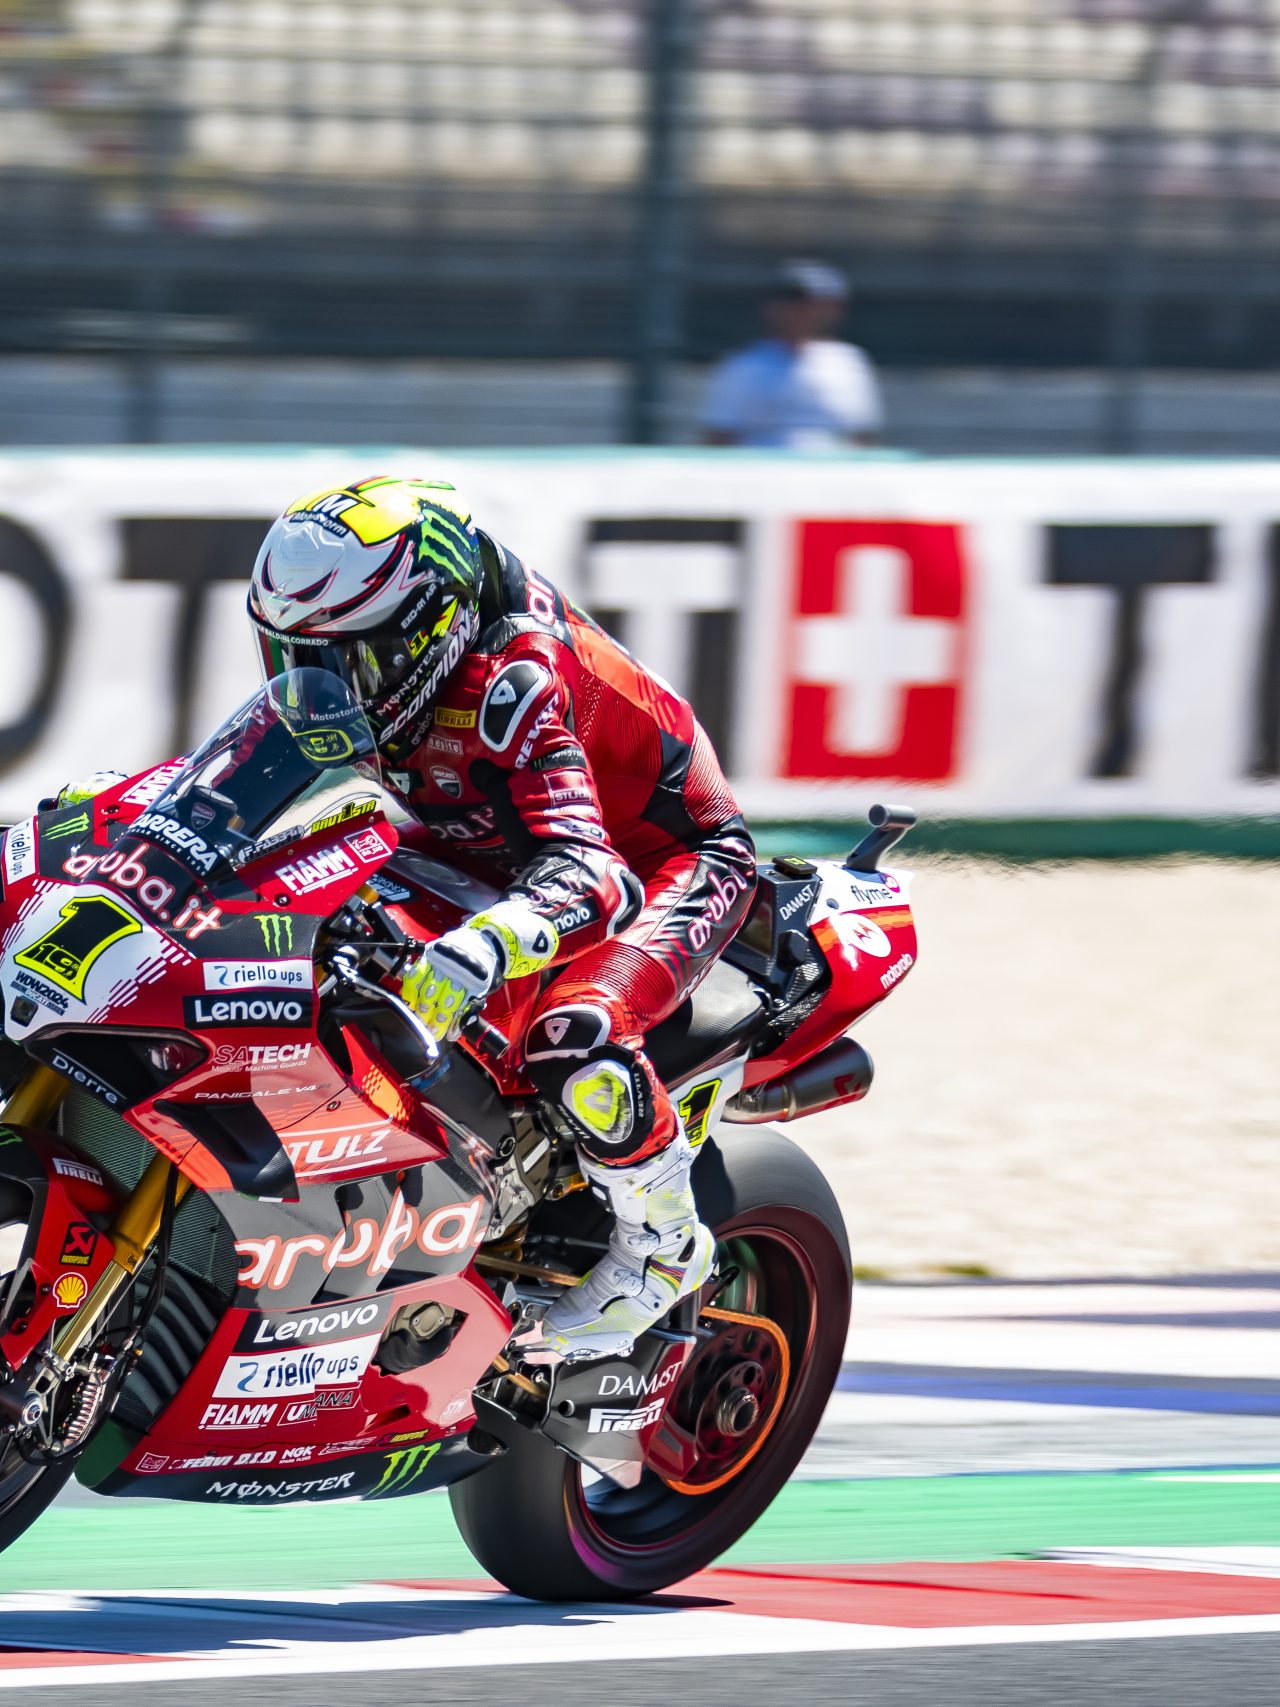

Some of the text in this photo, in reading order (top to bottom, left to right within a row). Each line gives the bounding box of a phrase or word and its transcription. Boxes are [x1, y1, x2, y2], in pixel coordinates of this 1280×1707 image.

[290, 637, 329, 646] CORRADO
[379, 612, 471, 744] SCORPION
[275, 845, 354, 891] FIAMM
[63, 842, 222, 940] aruba.it
[779, 884, 814, 920] DAMAST
[851, 885, 893, 904] flyme
[553, 907, 591, 932] novo
[14, 894, 144, 1006] 1
[234, 965, 303, 984] riello ups
[880, 953, 913, 989] motorola
[195, 999, 302, 1023] Lenovo
[213, 1043, 312, 1065] SATECH
[287, 1129, 391, 1168] TULZ
[52, 1157, 104, 1186] PIRELLI
[253, 1303, 379, 1344] Lenovo
[263, 1352, 359, 1389] riello ups
[598, 1361, 683, 1396] DAMAST
[200, 1403, 278, 1429] FIAMM
[587, 1398, 665, 1433] PIRELLI
[282, 1445, 317, 1459] NGK
